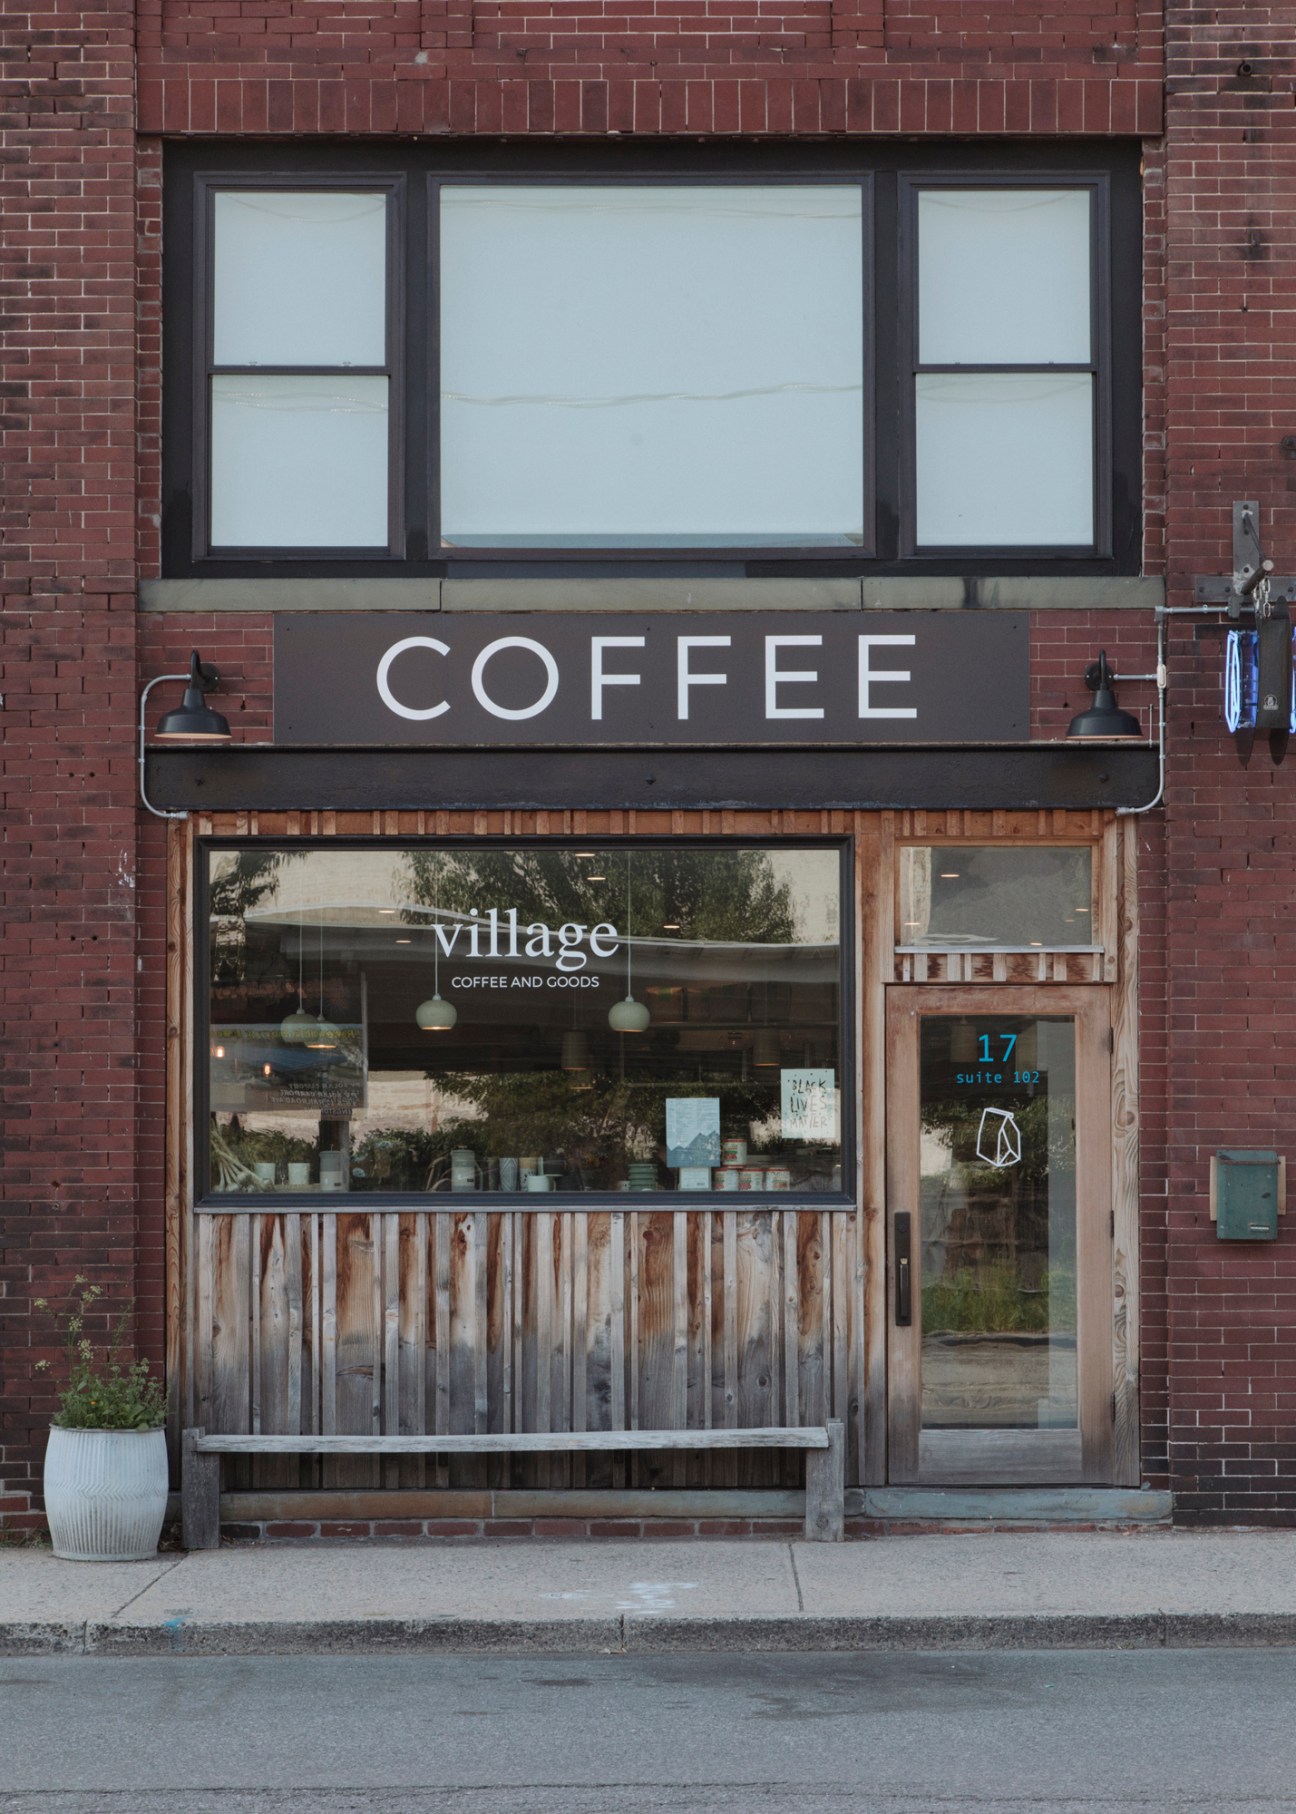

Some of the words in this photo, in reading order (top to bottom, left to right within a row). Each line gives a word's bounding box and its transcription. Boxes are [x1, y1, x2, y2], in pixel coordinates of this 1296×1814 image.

[376, 634, 918, 721] COFFEE
[430, 907, 620, 973] village
[451, 976, 508, 989] COFFEE
[510, 976, 543, 989] AND
[546, 976, 600, 989] GOODS
[978, 1033, 1018, 1063] 17
[792, 1078, 826, 1094] BLACK
[956, 1071, 1002, 1084] suite
[1013, 1071, 1040, 1084] 102
[790, 1095, 827, 1113] LIVES
[791, 1114, 828, 1129] MATTER
